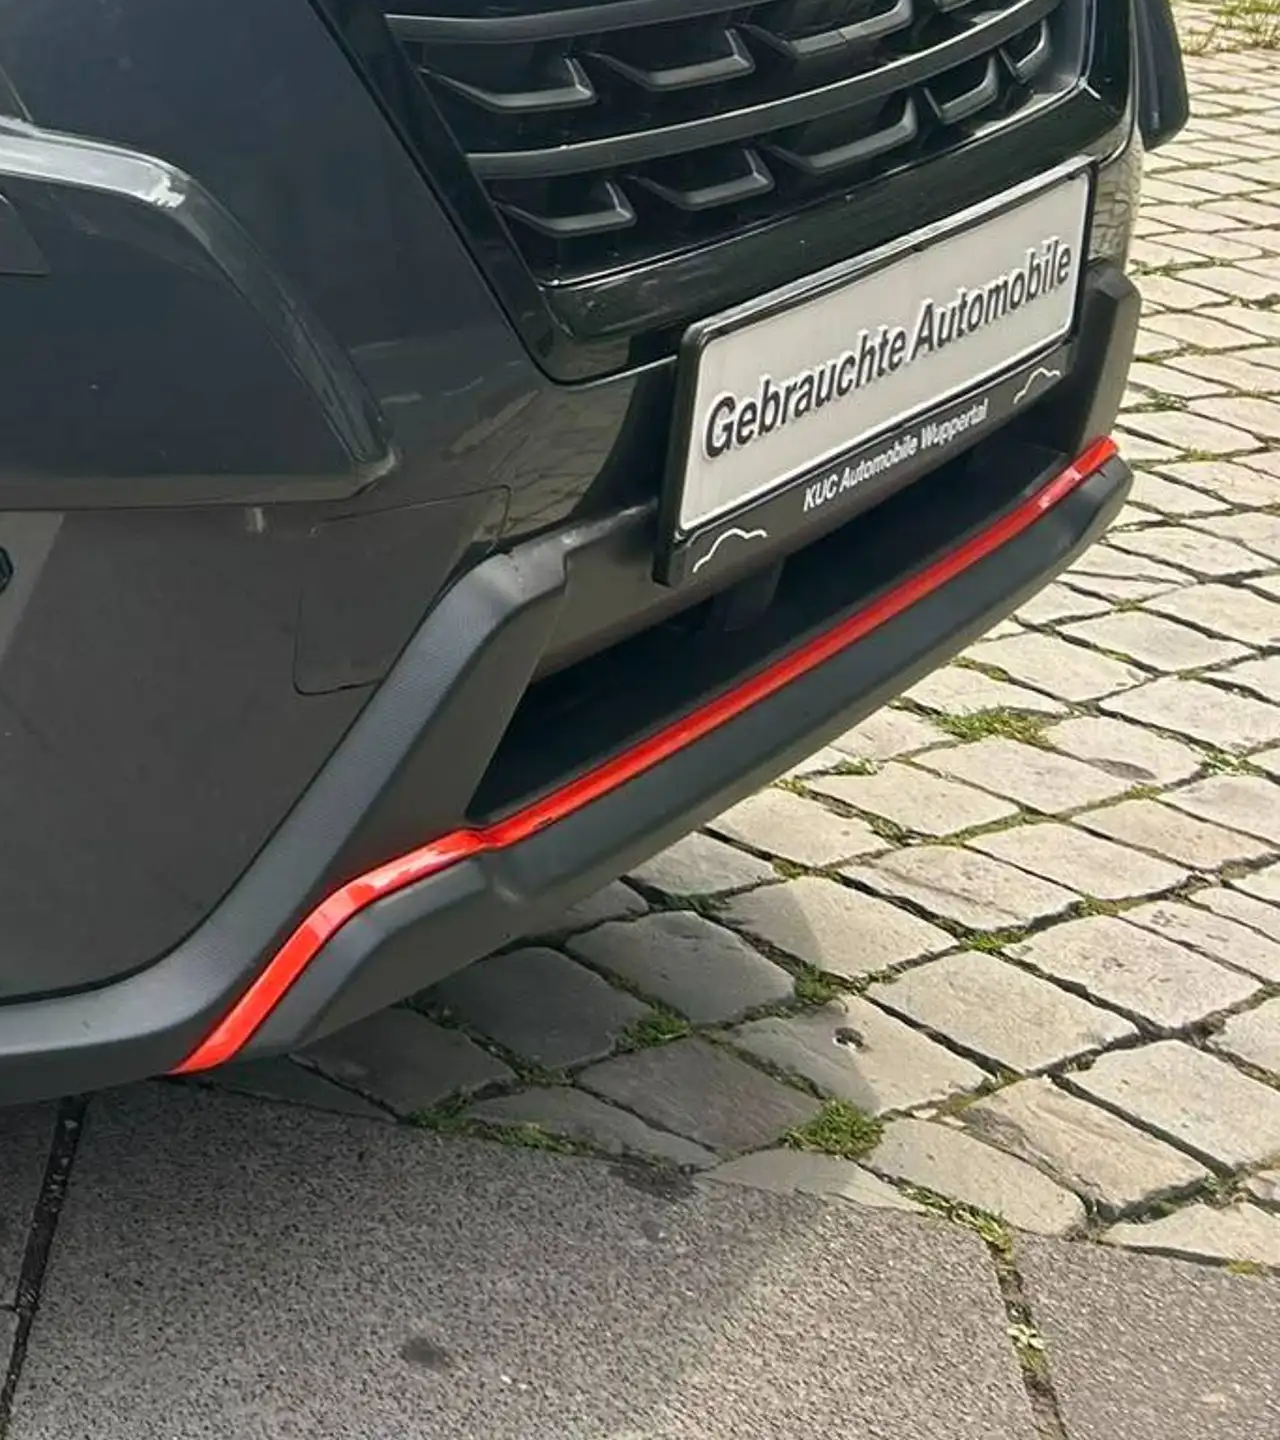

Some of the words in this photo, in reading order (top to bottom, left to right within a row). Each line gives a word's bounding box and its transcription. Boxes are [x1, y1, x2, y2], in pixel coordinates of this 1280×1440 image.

[705, 328, 907, 459] Gebrauchte
[910, 237, 1072, 362] Automobile
[803, 474, 839, 513] KUC
[839, 434, 918, 492] Automobile
[920, 397, 989, 450] Wuppertal
